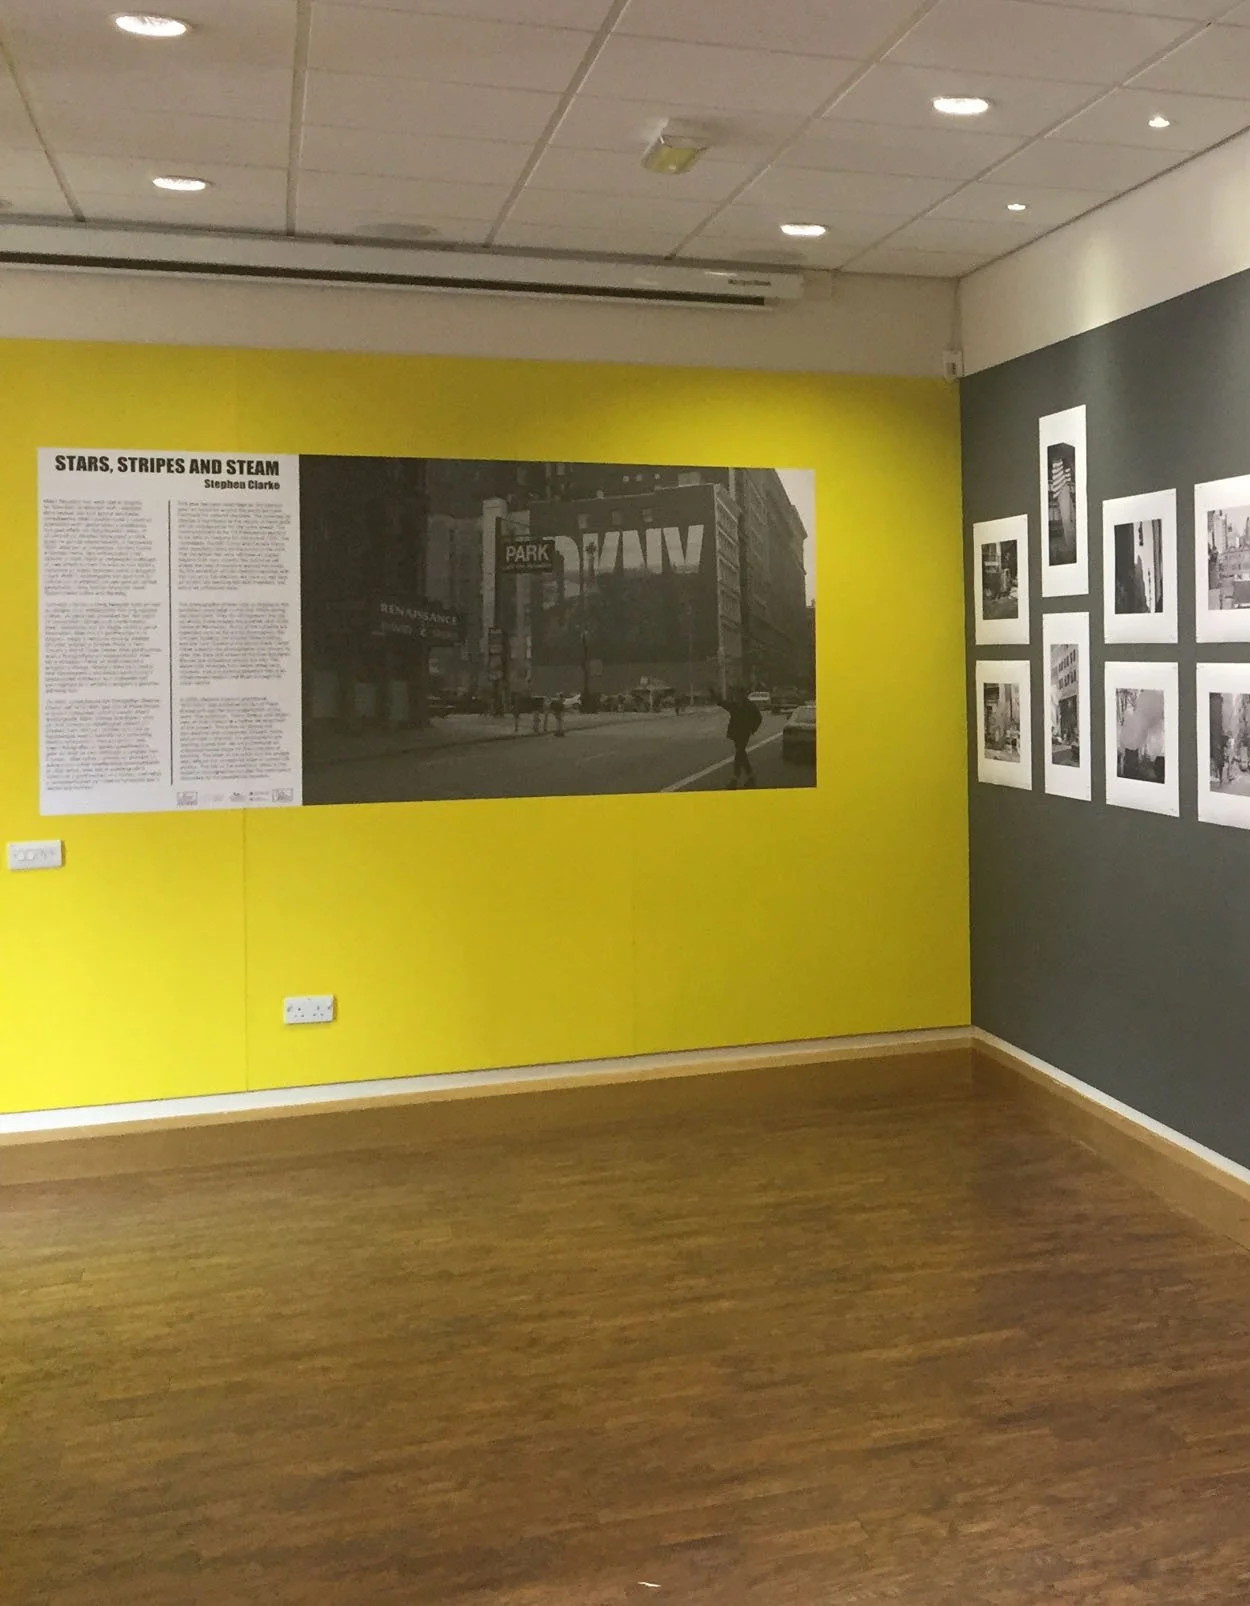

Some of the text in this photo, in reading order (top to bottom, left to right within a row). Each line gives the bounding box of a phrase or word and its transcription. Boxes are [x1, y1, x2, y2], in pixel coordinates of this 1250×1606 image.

[55, 455, 280, 476] STARS, STRIPES AND STEAM
[204, 478, 281, 490] Stephen Clarke
[505, 544, 550, 562] PARK
